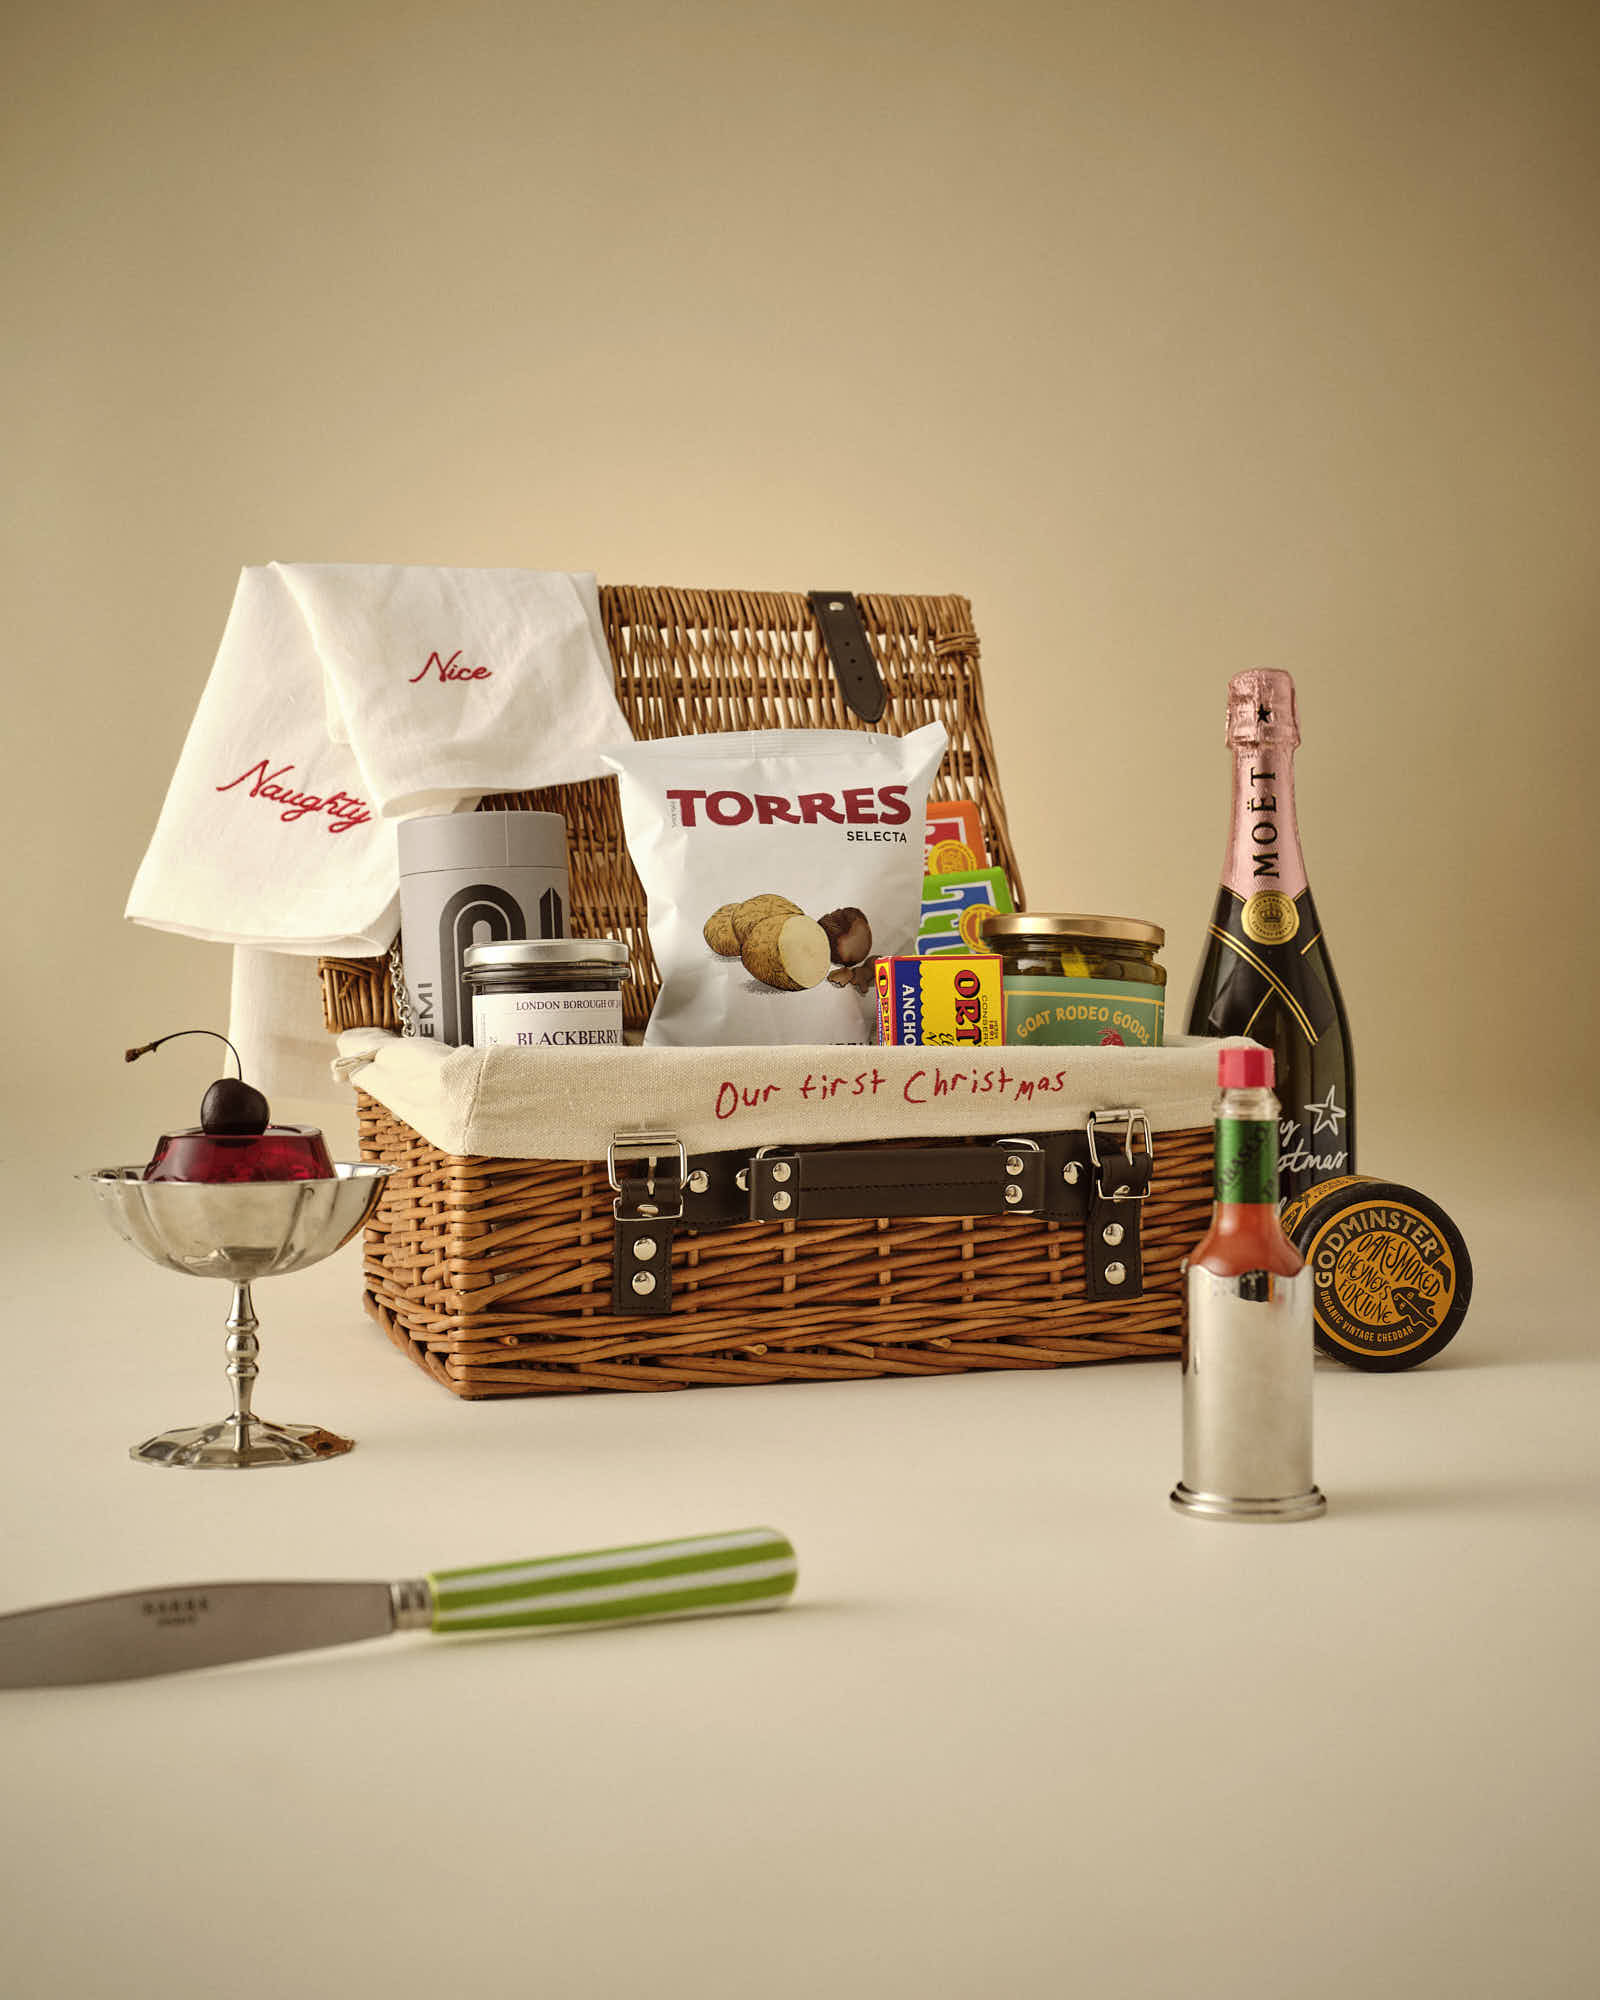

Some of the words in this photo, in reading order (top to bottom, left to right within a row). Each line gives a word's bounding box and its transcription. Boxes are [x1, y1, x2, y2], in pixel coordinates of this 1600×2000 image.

[408, 650, 492, 683] Nice
[216, 759, 372, 833] Naughty
[666, 785, 912, 827] TORRES
[846, 831, 907, 844] SELECTA
[1247, 767, 1280, 878] MOËT
[516, 1000, 561, 1011] LONDON
[563, 998, 607, 1009] BOROUGH
[1016, 1009, 1051, 1039] GOAT
[1056, 1005, 1110, 1022] RODEO
[1113, 1010, 1150, 1045] GOODS
[715, 1081, 781, 1119] Our
[903, 1067, 1067, 1103] Christmas
[1315, 1209, 1440, 1288] GODMINSTER
[1320, 1289, 1345, 1325] ORGANIC
[1342, 1319, 1375, 1342] VINTAGE
[1376, 1325, 1415, 1342] CHEDDAR
[1339, 1279, 1393, 1325] FORTUNE
